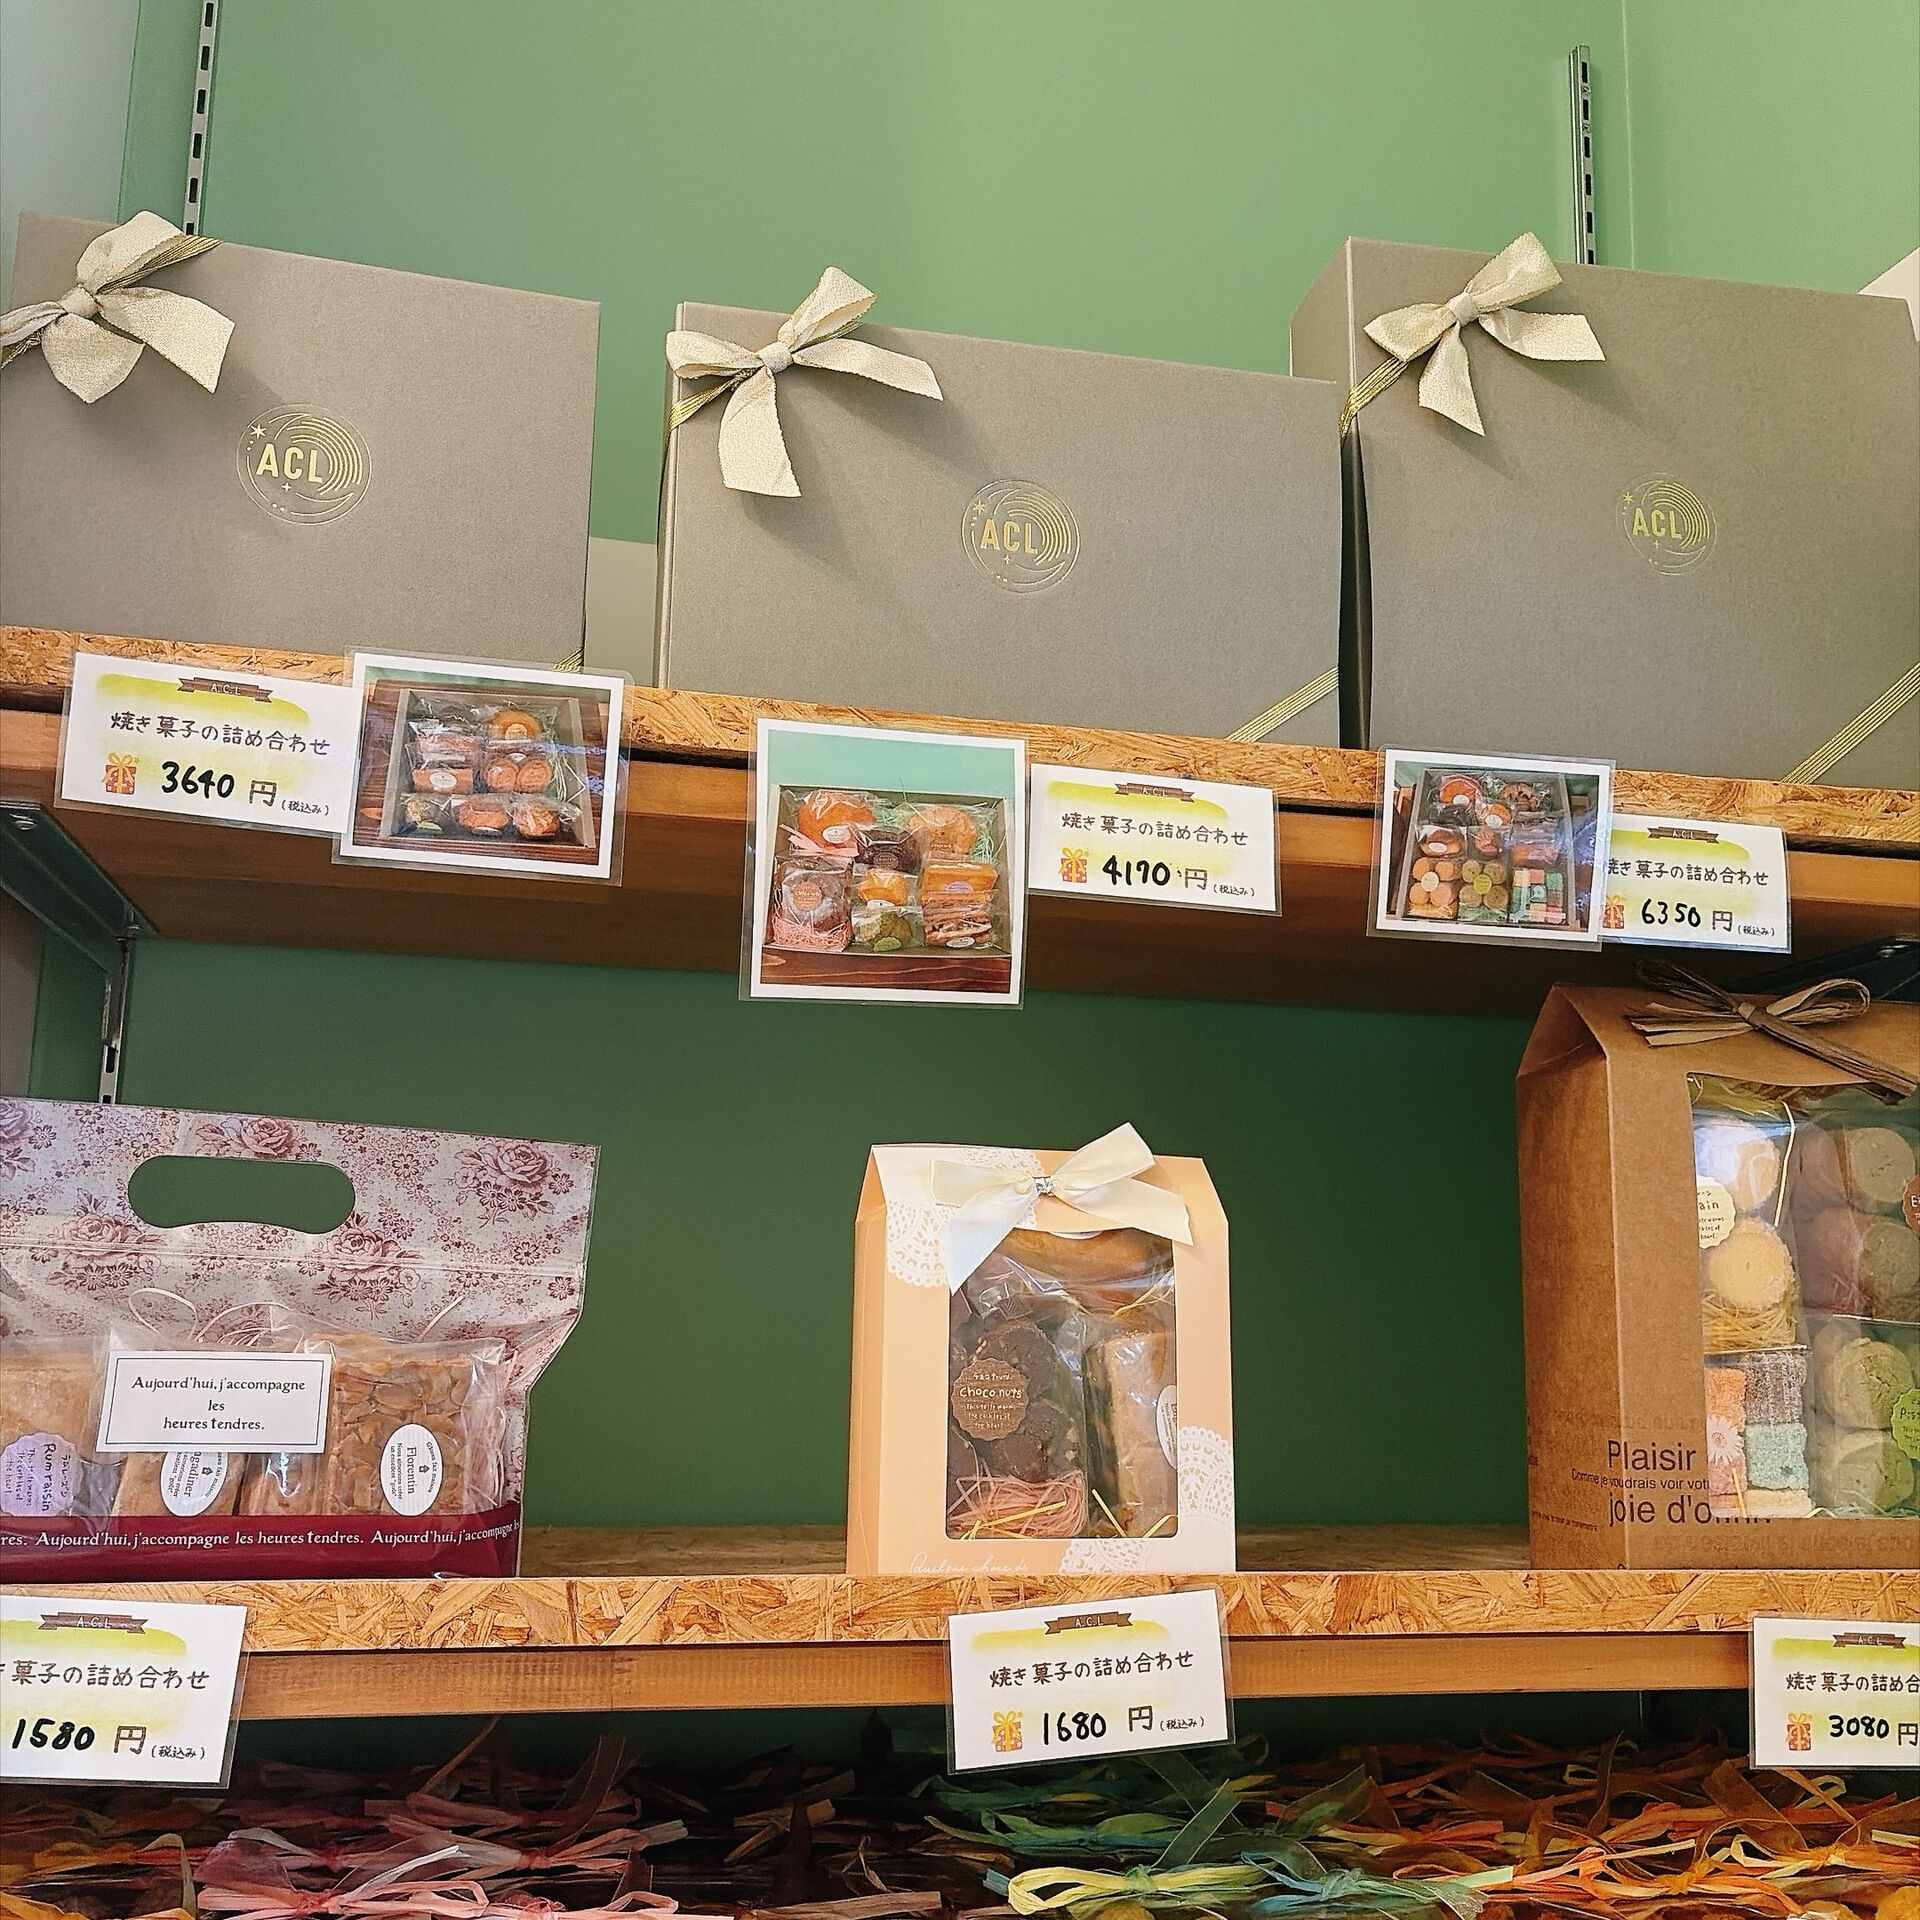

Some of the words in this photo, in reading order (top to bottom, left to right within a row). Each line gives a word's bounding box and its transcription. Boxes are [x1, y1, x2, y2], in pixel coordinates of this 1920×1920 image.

[256, 443, 323, 483] ACL
[981, 518, 1037, 555] ACL
[1633, 507, 1682, 539] ACL
[210, 683, 242, 696] A.C.L
[110, 711, 331, 756] 焼き菓子の詰め合わせ
[161, 761, 235, 799] 3640
[249, 780, 277, 807] 円
[1142, 788, 1170, 797] A.C.L
[1061, 813, 1248, 846] 焼き菓子の詰め合わせ
[1184, 868, 1208, 890] 円
[1641, 898, 1701, 928] 6350
[1712, 910, 1733, 932] 円
[208, 1399, 225, 1411] les
[163, 1417, 208, 1429] heures
[211, 1417, 265, 1430] tendres.
[43, 1443, 57, 1471] Rum
[406, 1446, 417, 1494] Florentin
[1608, 1440, 1697, 1471] Plaisir
[41, 1474, 53, 1512] raisin
[1571, 1468, 1599, 1484] Comme
[1610, 1477, 1656, 1489] voudrais
[1660, 1479, 1683, 1490] voir
[1609, 1492, 1655, 1527] joie
[235, 1532, 253, 1544] les
[257, 1531, 304, 1544] heures
[307, 1531, 364, 1544] tendres.
[76, 1617, 113, 1629] A.C.L
[1074, 1616, 1104, 1628] A.C.L
[0, 1660, 210, 1690] 菓子の詰め合わせ
[990, 1651, 1194, 1689] 焼き菓子の詰め合わせ
[12, 1718, 96, 1751] 1580
[113, 1725, 147, 1755] 円
[1043, 1711, 1107, 1745] 1680
[1128, 1705, 1153, 1732] 円
[1828, 1714, 1890, 1739] 3080
[1897, 1722, 1919, 1747] 円
